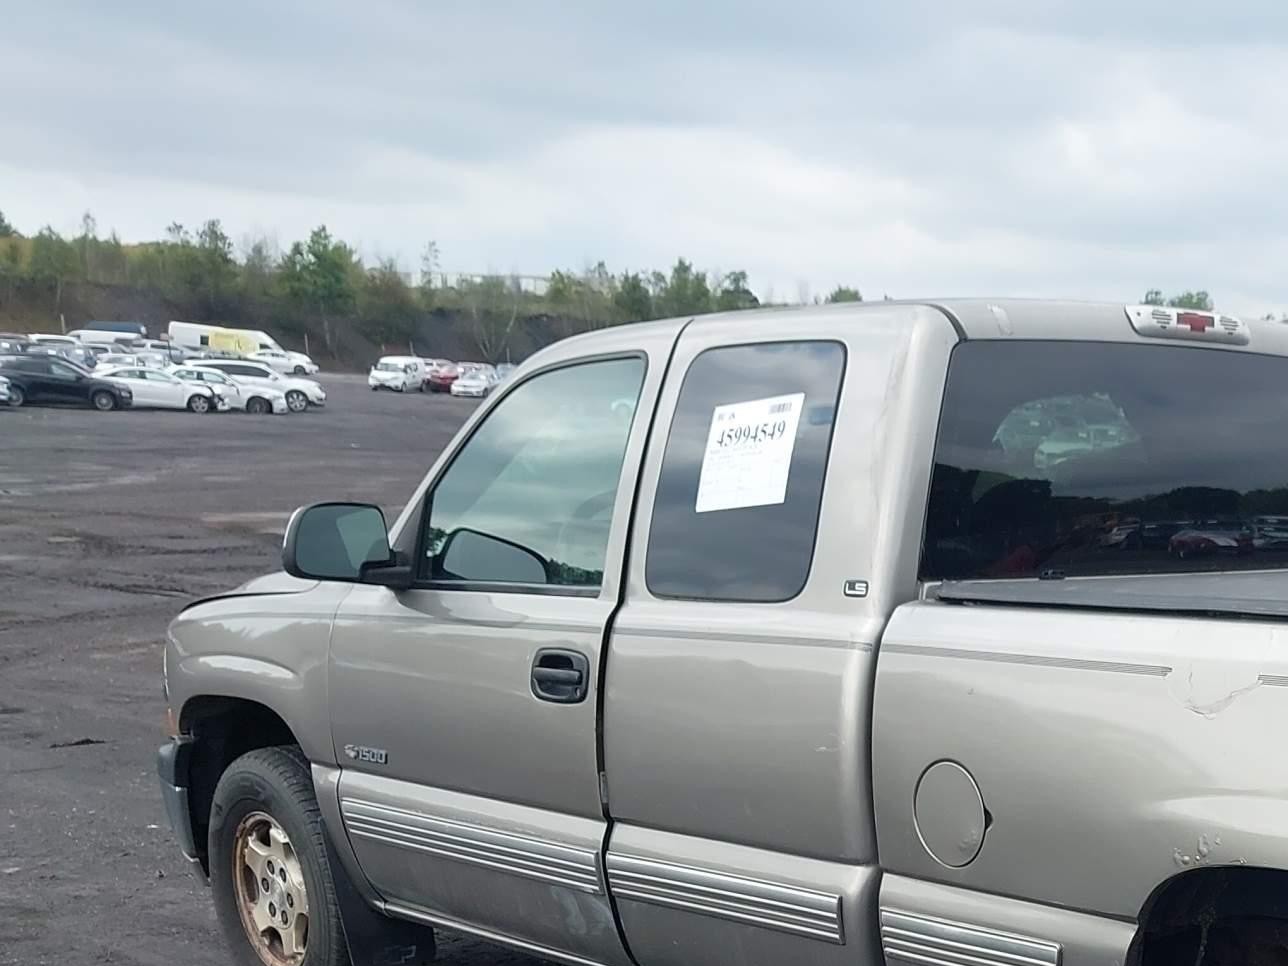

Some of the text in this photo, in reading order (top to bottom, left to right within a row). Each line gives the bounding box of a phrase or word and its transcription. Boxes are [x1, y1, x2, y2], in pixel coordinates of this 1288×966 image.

[716, 420, 787, 448] 45994549
[845, 582, 867, 595] LS
[359, 746, 386, 763] 1500
